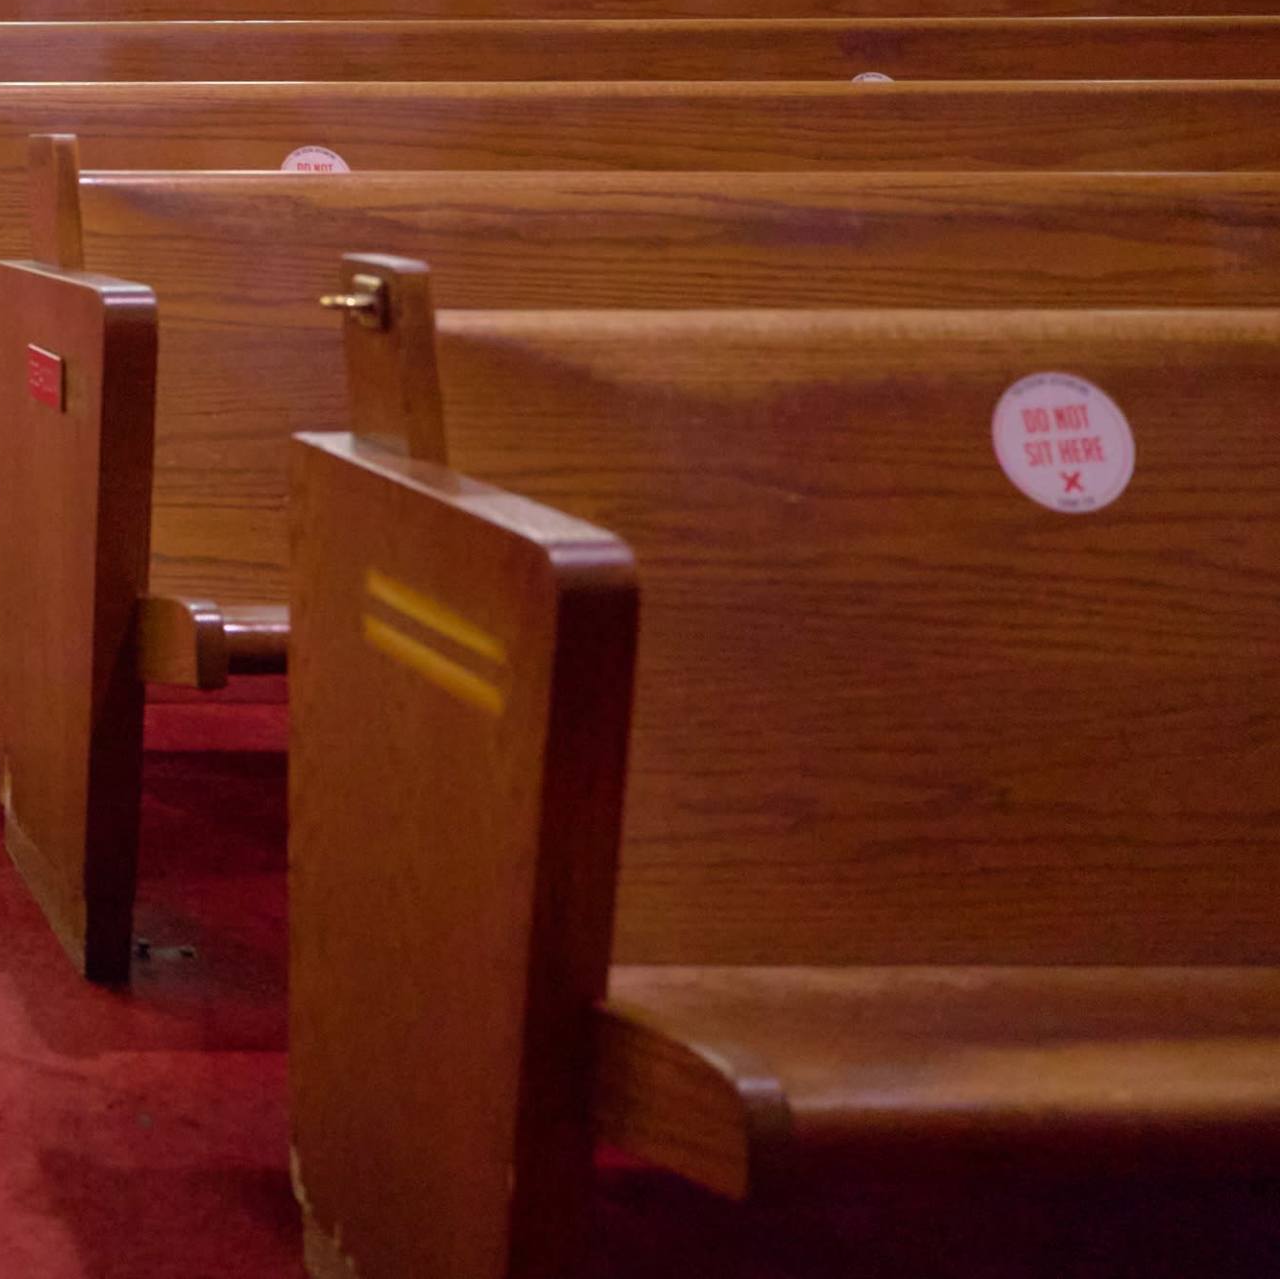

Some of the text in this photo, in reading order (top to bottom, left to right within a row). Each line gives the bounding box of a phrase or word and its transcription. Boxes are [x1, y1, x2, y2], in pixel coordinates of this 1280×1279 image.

[1022, 404, 1089, 433] DO NOT
[1024, 436, 1105, 466] SIT HERE
